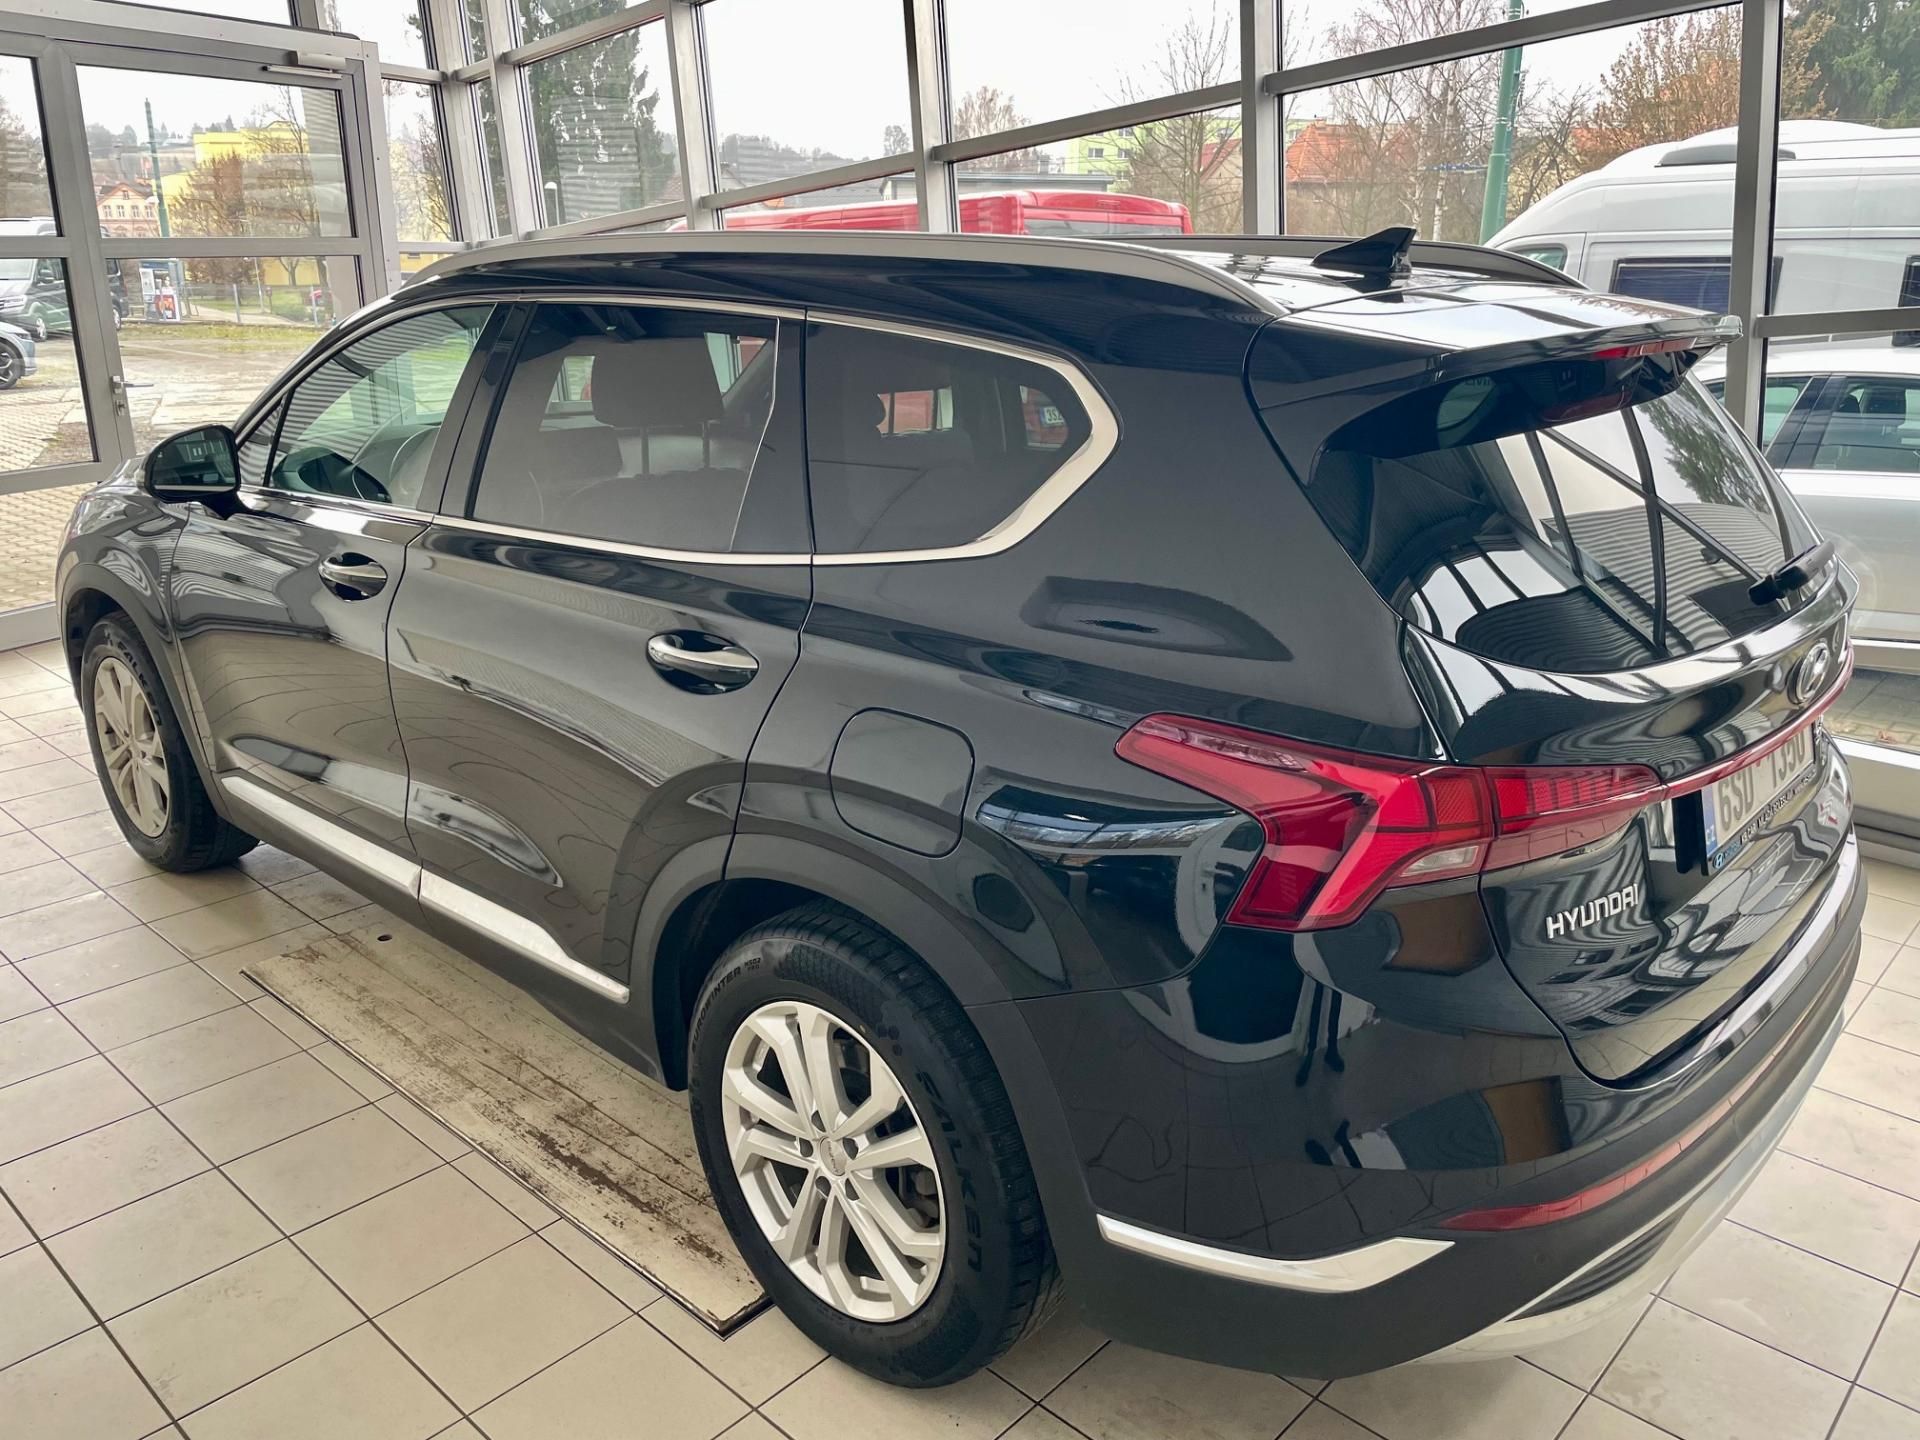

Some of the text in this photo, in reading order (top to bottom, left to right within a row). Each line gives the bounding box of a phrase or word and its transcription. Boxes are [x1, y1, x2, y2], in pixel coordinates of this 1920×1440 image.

[1545, 883, 1639, 939] HYUNDAI
[692, 966, 741, 1053] EUROWINTER
[915, 1070, 982, 1273] FALKEN
